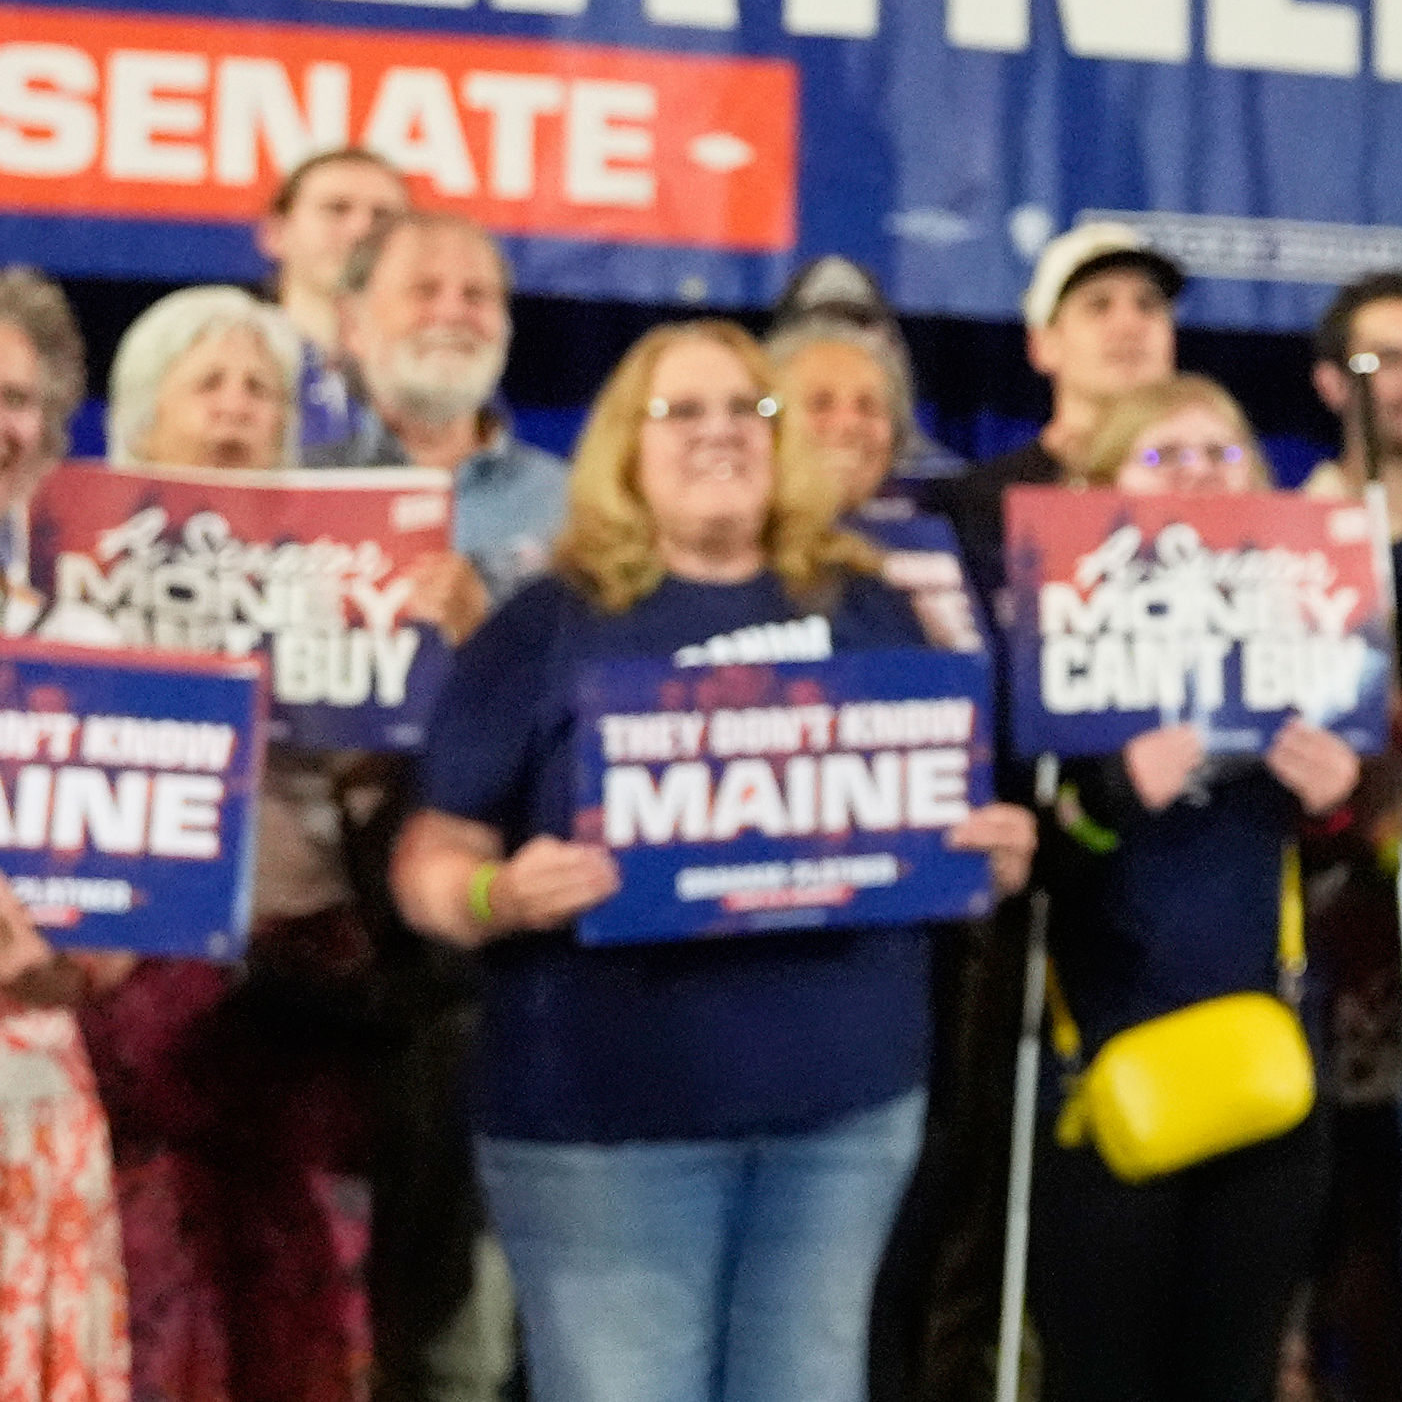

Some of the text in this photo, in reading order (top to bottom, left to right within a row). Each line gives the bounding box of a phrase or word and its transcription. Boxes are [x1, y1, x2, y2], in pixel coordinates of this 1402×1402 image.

[0, 42, 658, 208] SENATE
[273, 626, 420, 707] BUY
[0, 763, 225, 859] INE
[603, 747, 971, 848] MAINE
